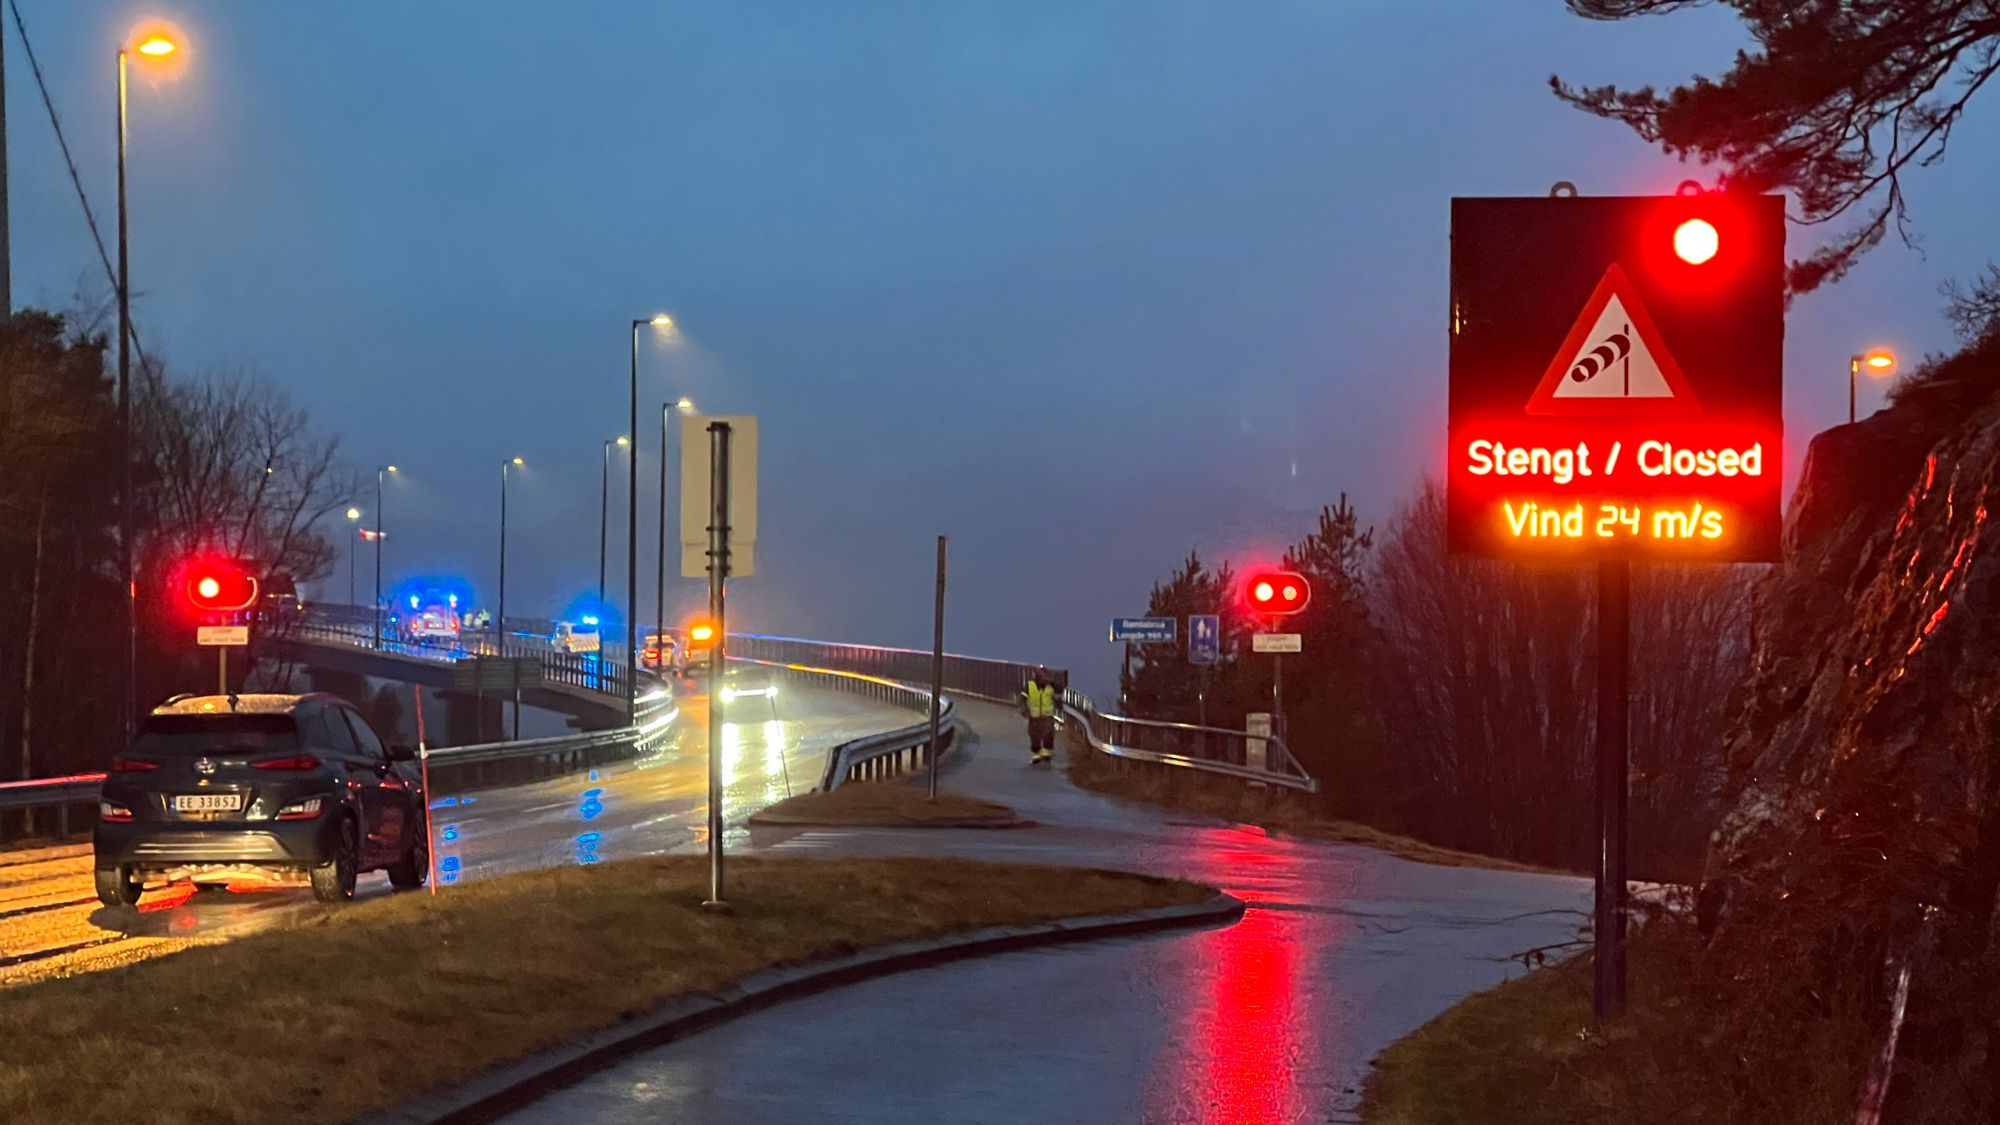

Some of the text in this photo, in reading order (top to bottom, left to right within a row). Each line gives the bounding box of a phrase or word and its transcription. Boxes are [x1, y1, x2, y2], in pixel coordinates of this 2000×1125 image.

[1467, 439, 1763, 485] Stengt / Closed
[1503, 501, 1723, 538] Vind 24 m/s
[179, 796, 237, 809] EE 33852
